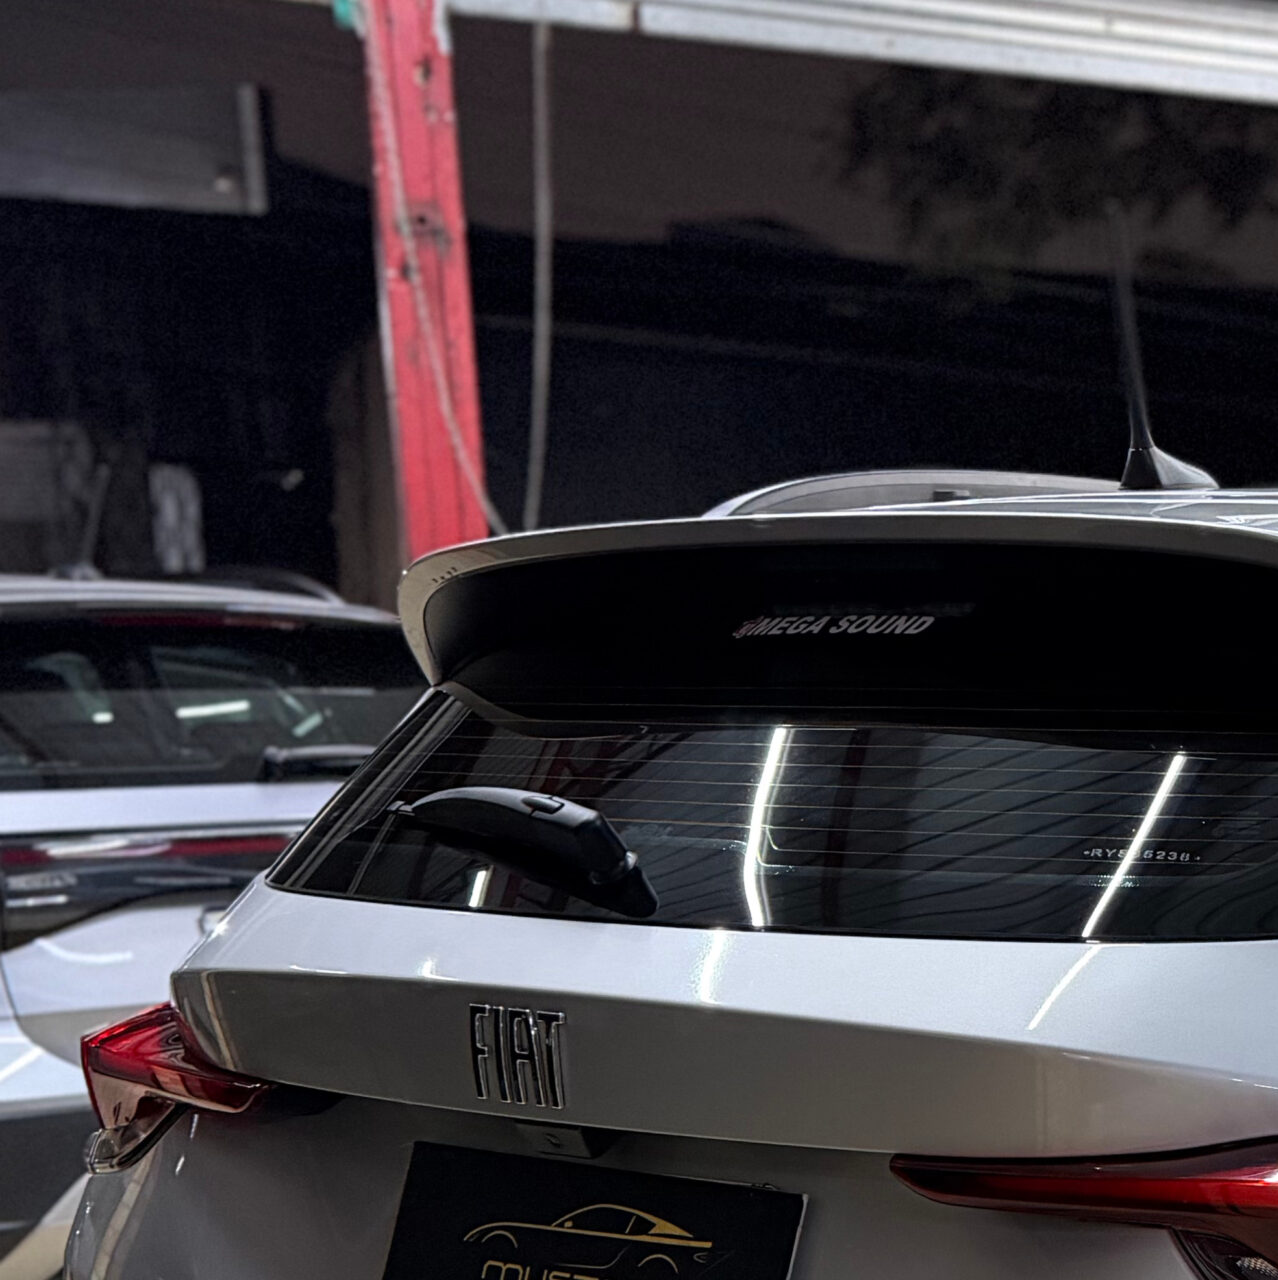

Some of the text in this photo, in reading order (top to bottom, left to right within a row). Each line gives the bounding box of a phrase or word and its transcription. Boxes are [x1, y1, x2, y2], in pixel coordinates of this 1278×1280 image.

[746, 615, 935, 636] MEGA SOUND
[469, 1003, 566, 1109] FIAT
